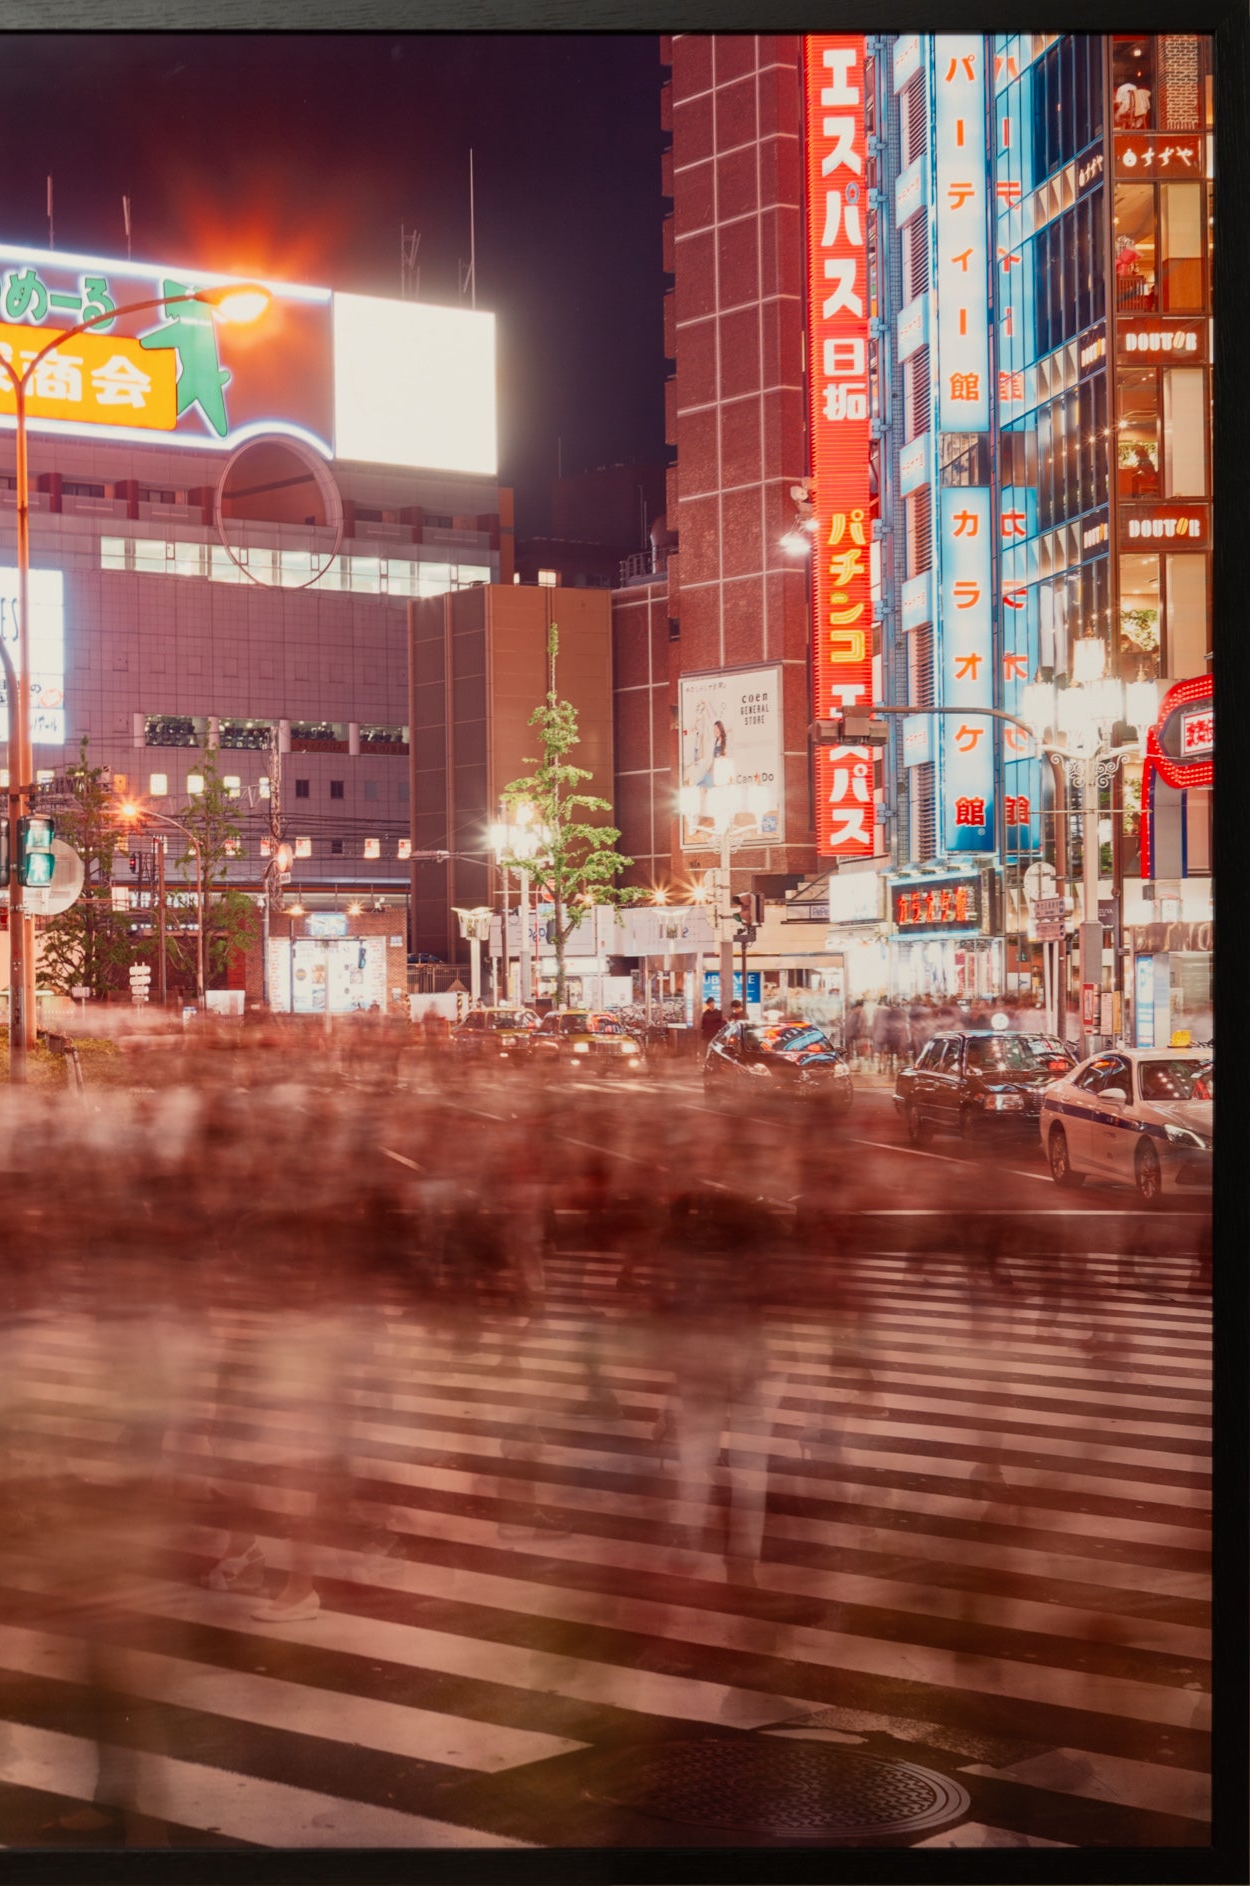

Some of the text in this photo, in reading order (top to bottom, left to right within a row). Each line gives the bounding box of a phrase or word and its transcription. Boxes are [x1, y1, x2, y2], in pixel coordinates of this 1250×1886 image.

[945, 54, 980, 401] パーティー館
[1125, 331, 1197, 352] DOUTOR
[1128, 517, 1200, 538] DOUTOR
[827, 508, 866, 663] パチンコ
[952, 509, 986, 826] カラオケ館
[741, 692, 768, 704] coen
[740, 703, 769, 715] GENERAL
[744, 715, 765, 726] STORE
